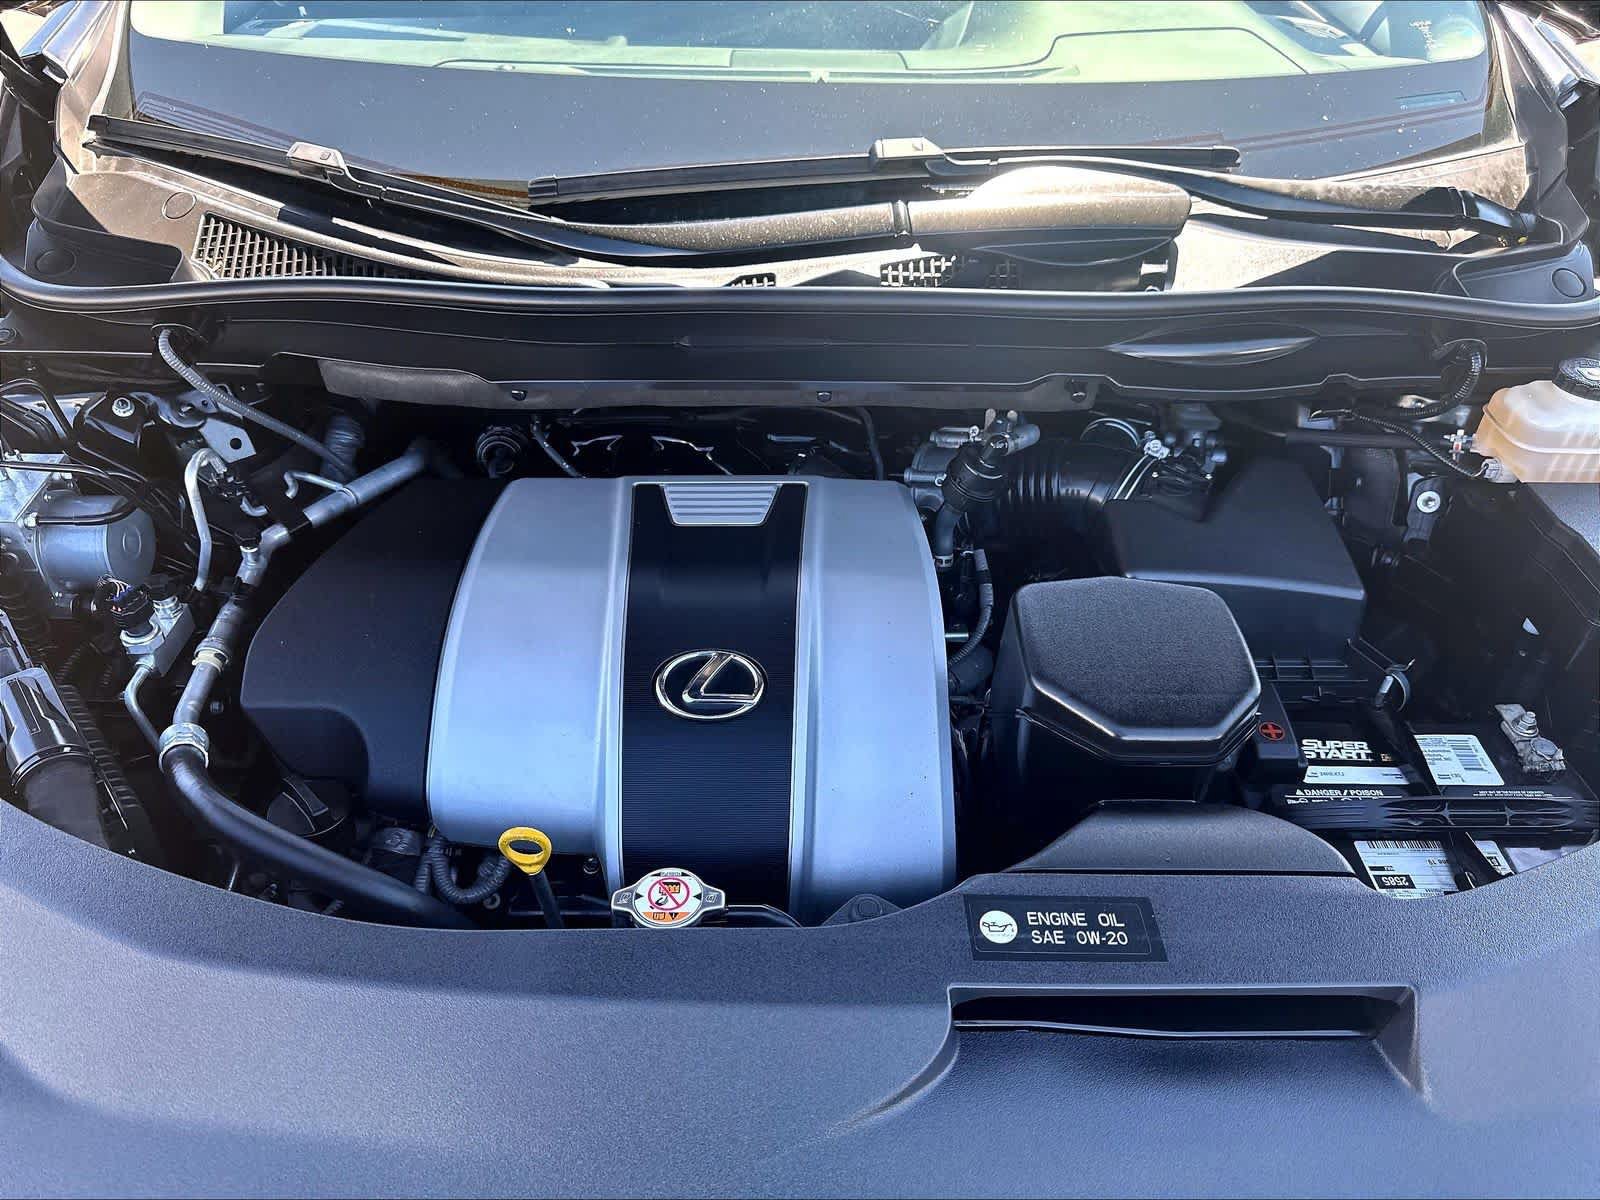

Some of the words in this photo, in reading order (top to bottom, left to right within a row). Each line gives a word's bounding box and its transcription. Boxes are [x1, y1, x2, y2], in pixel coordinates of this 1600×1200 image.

[1301, 739, 1369, 751] SUPER
[1303, 749, 1373, 761] START
[1303, 789, 1342, 797] DANGER
[1349, 789, 1384, 797] POISON
[1381, 876, 1409, 886] 2585
[1026, 912, 1088, 926] ENGINE
[1098, 913, 1125, 927] OIL
[1031, 930, 1066, 945] SAE
[1076, 931, 1128, 945] 0W-20
